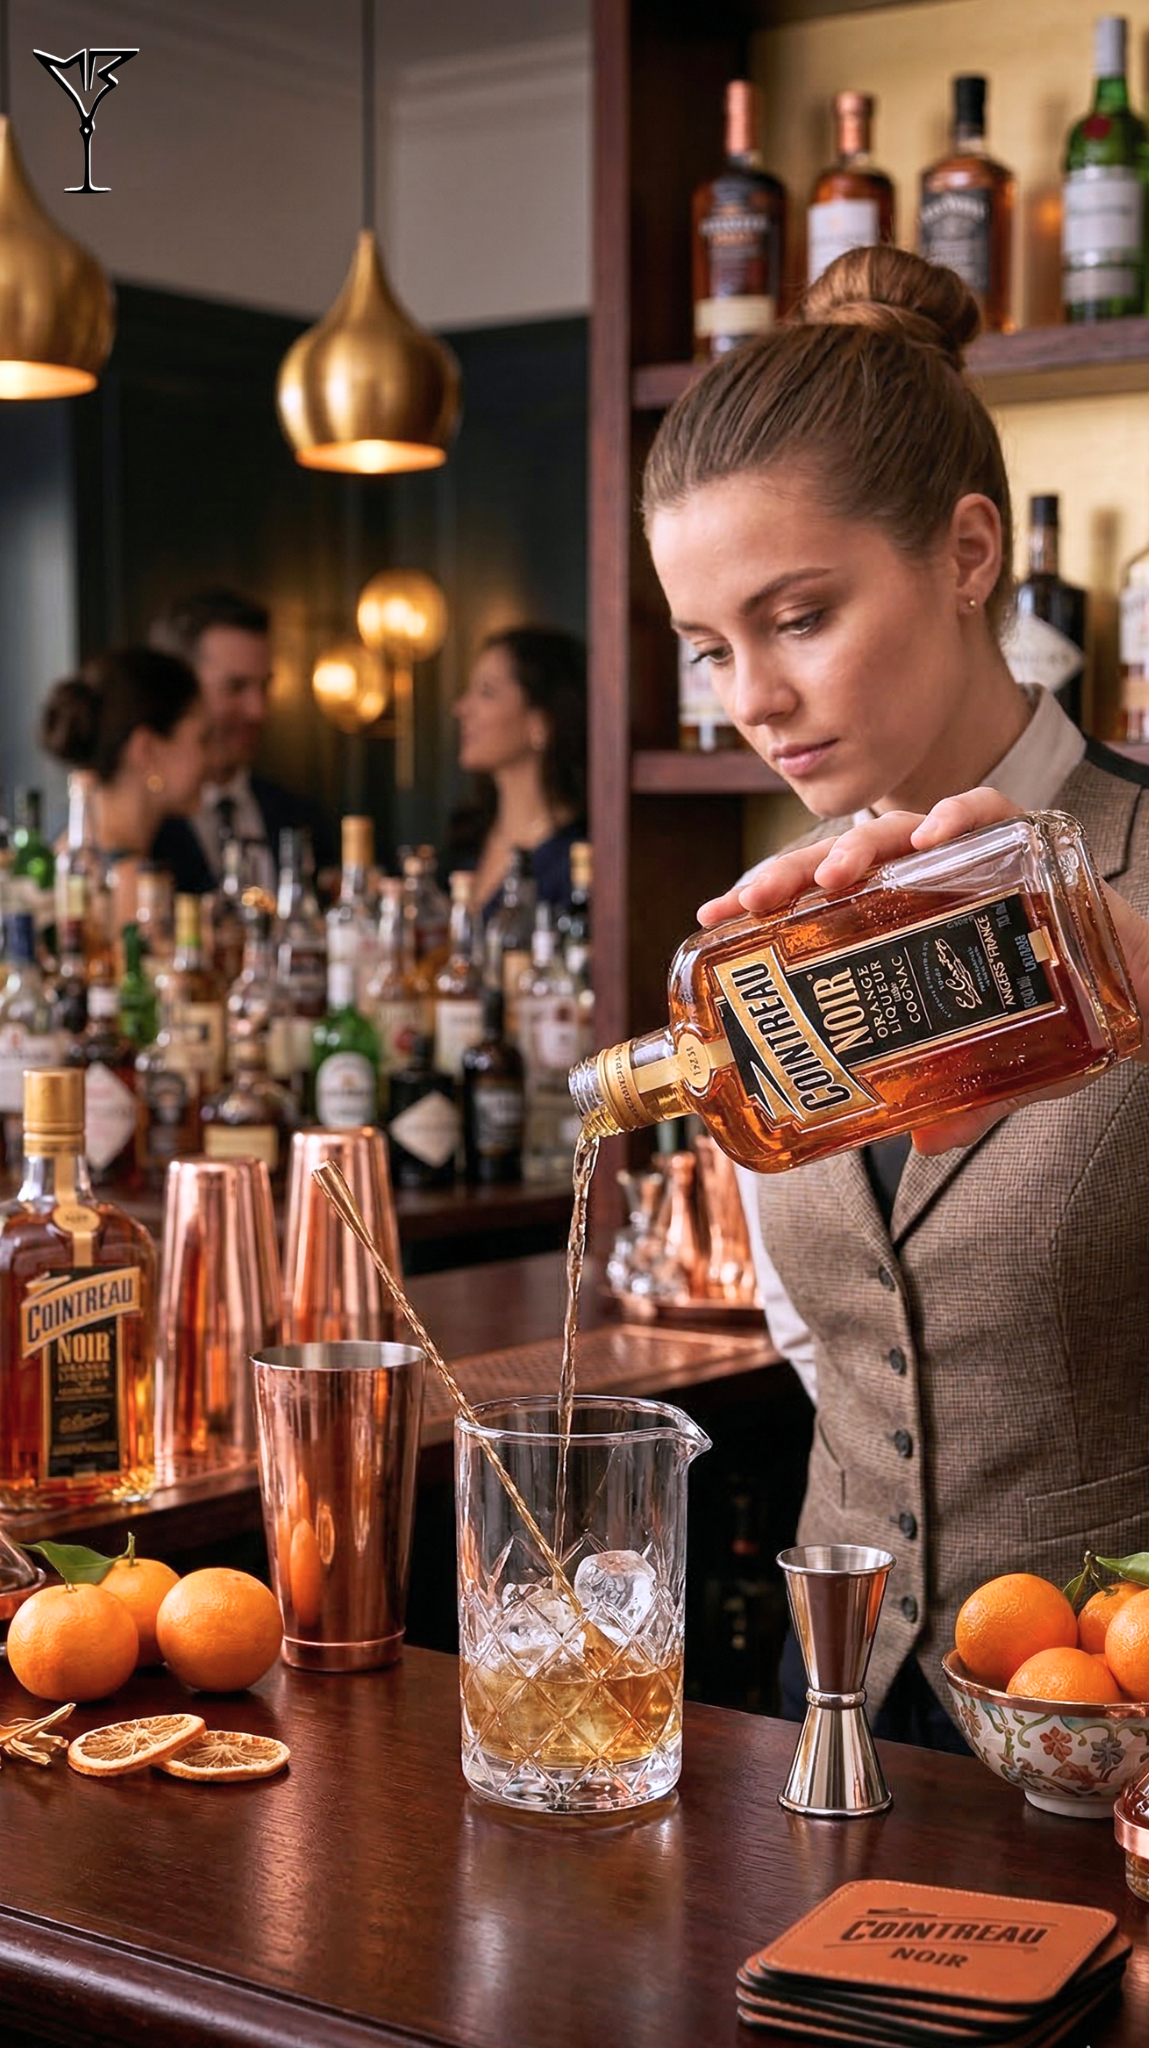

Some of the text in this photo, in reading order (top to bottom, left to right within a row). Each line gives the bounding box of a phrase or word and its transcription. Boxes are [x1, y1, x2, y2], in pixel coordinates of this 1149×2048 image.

[977, 914, 1000, 957] FRANCE
[813, 967, 873, 1054] NOIR
[857, 965, 888, 1038] ORANGE
[870, 960, 902, 1034] LIQUEUR
[891, 955, 921, 1023] COGNAC
[993, 961, 1016, 1005] ANGERS
[731, 962, 852, 1112] COINTREAU
[28, 1278, 133, 1343] COINTREAU
[57, 1332, 110, 1364] NOIR
[841, 1920, 1048, 1944] COINTREAU
[890, 1947, 968, 1968] NOIR
